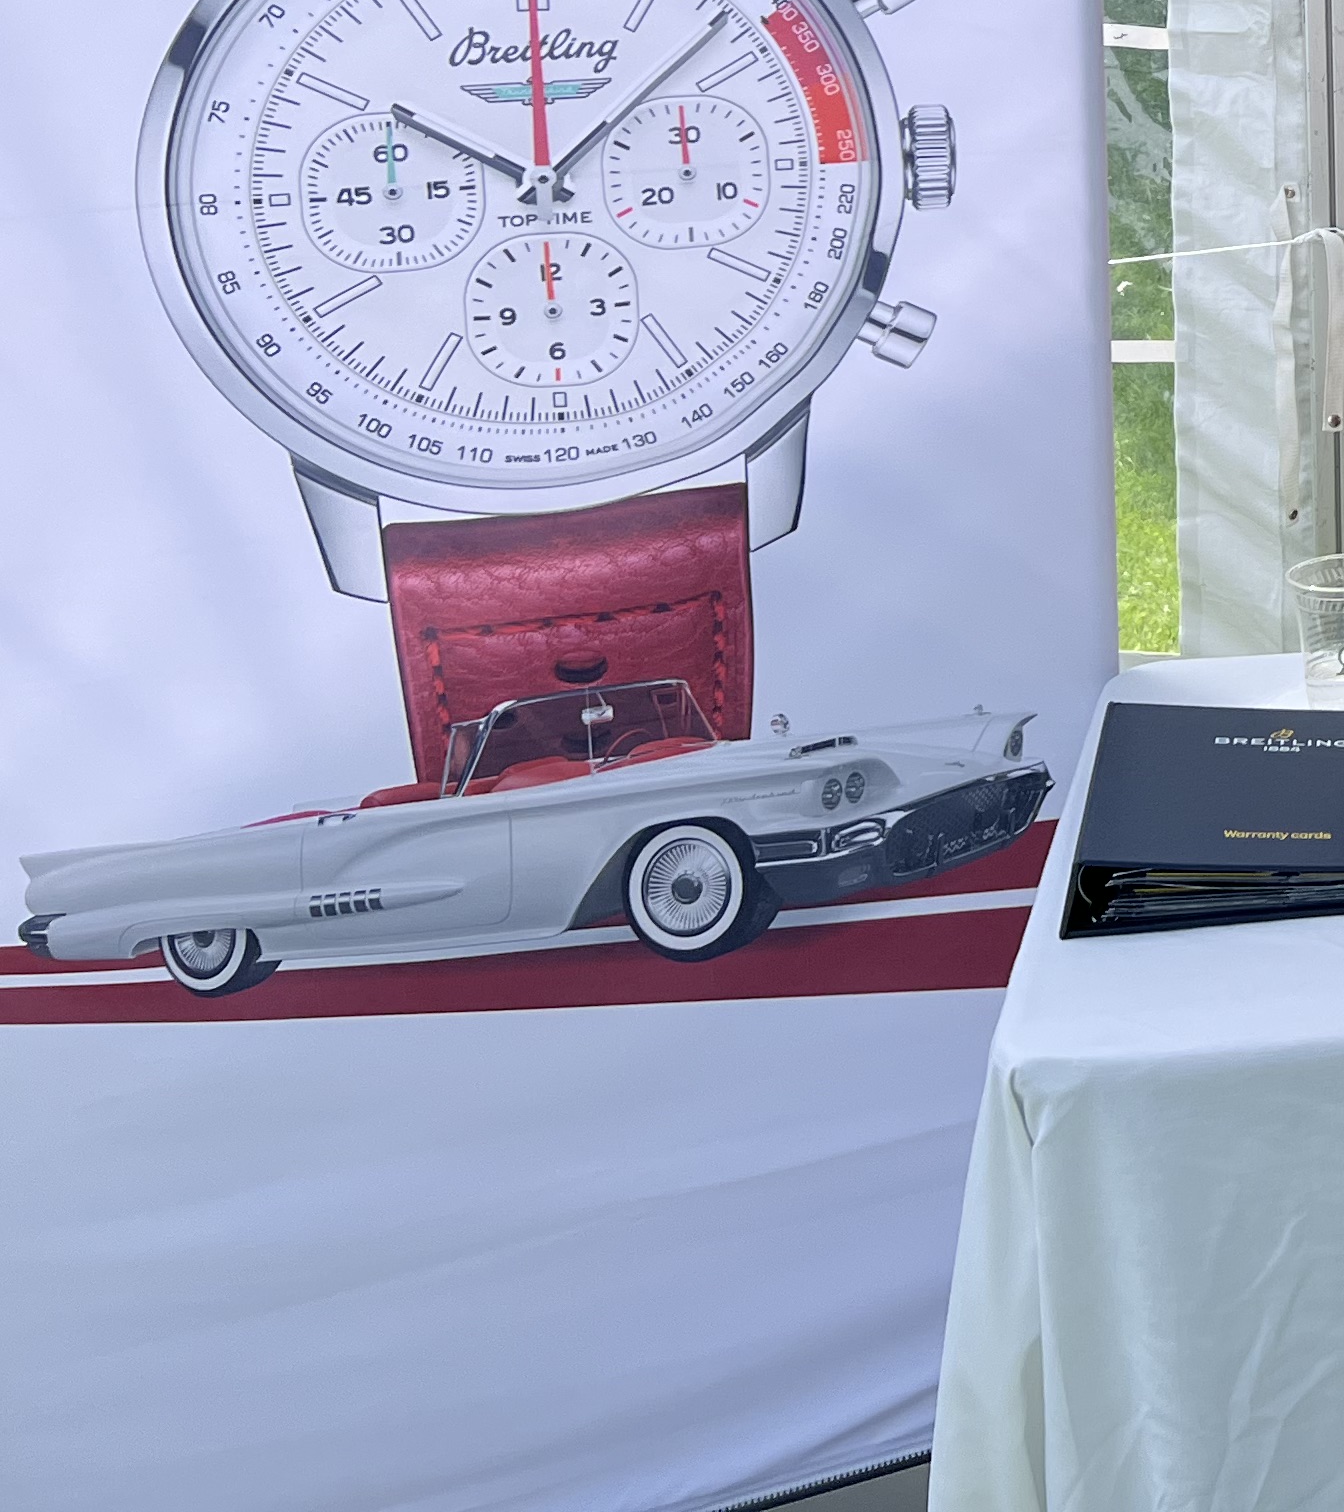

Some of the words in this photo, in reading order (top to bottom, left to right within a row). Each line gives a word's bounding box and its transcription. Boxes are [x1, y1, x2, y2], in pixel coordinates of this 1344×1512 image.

[258, 4, 285, 28] 70
[791, 21, 820, 53] 350
[816, 63, 840, 96] 300
[207, 100, 230, 124] 75
[668, 125, 701, 144] 30
[836, 129, 855, 161] 250
[373, 143, 408, 163] 60
[336, 186, 373, 206] 45
[426, 180, 451, 199] 15
[641, 186, 675, 206] 20
[716, 182, 738, 201] 10
[837, 183, 855, 214] 220
[199, 193, 218, 216] 80
[498, 214, 538, 228] TOP
[546, 211, 593, 225] IME
[378, 224, 415, 245] 30
[827, 227, 847, 260] 200
[217, 270, 241, 295] 85
[540, 262, 562, 282] 12
[803, 281, 829, 311] 180
[499, 307, 517, 326] 9
[589, 298, 606, 316] 3
[256, 333, 281, 357] 90
[549, 342, 566, 360] 6
[758, 342, 789, 370] 160
[306, 381, 333, 405] 95
[723, 371, 755, 399] 150
[357, 413, 392, 439] 100
[681, 403, 713, 429] 140
[408, 433, 443, 455] 105
[622, 431, 657, 450] 130
[457, 445, 493, 463] 110
[504, 454, 541, 463] SWISS
[586, 443, 619, 456] MADE
[543, 446, 580, 464] 120
[1224, 829, 1288, 840] Warranty
[1290, 831, 1332, 840] cards
